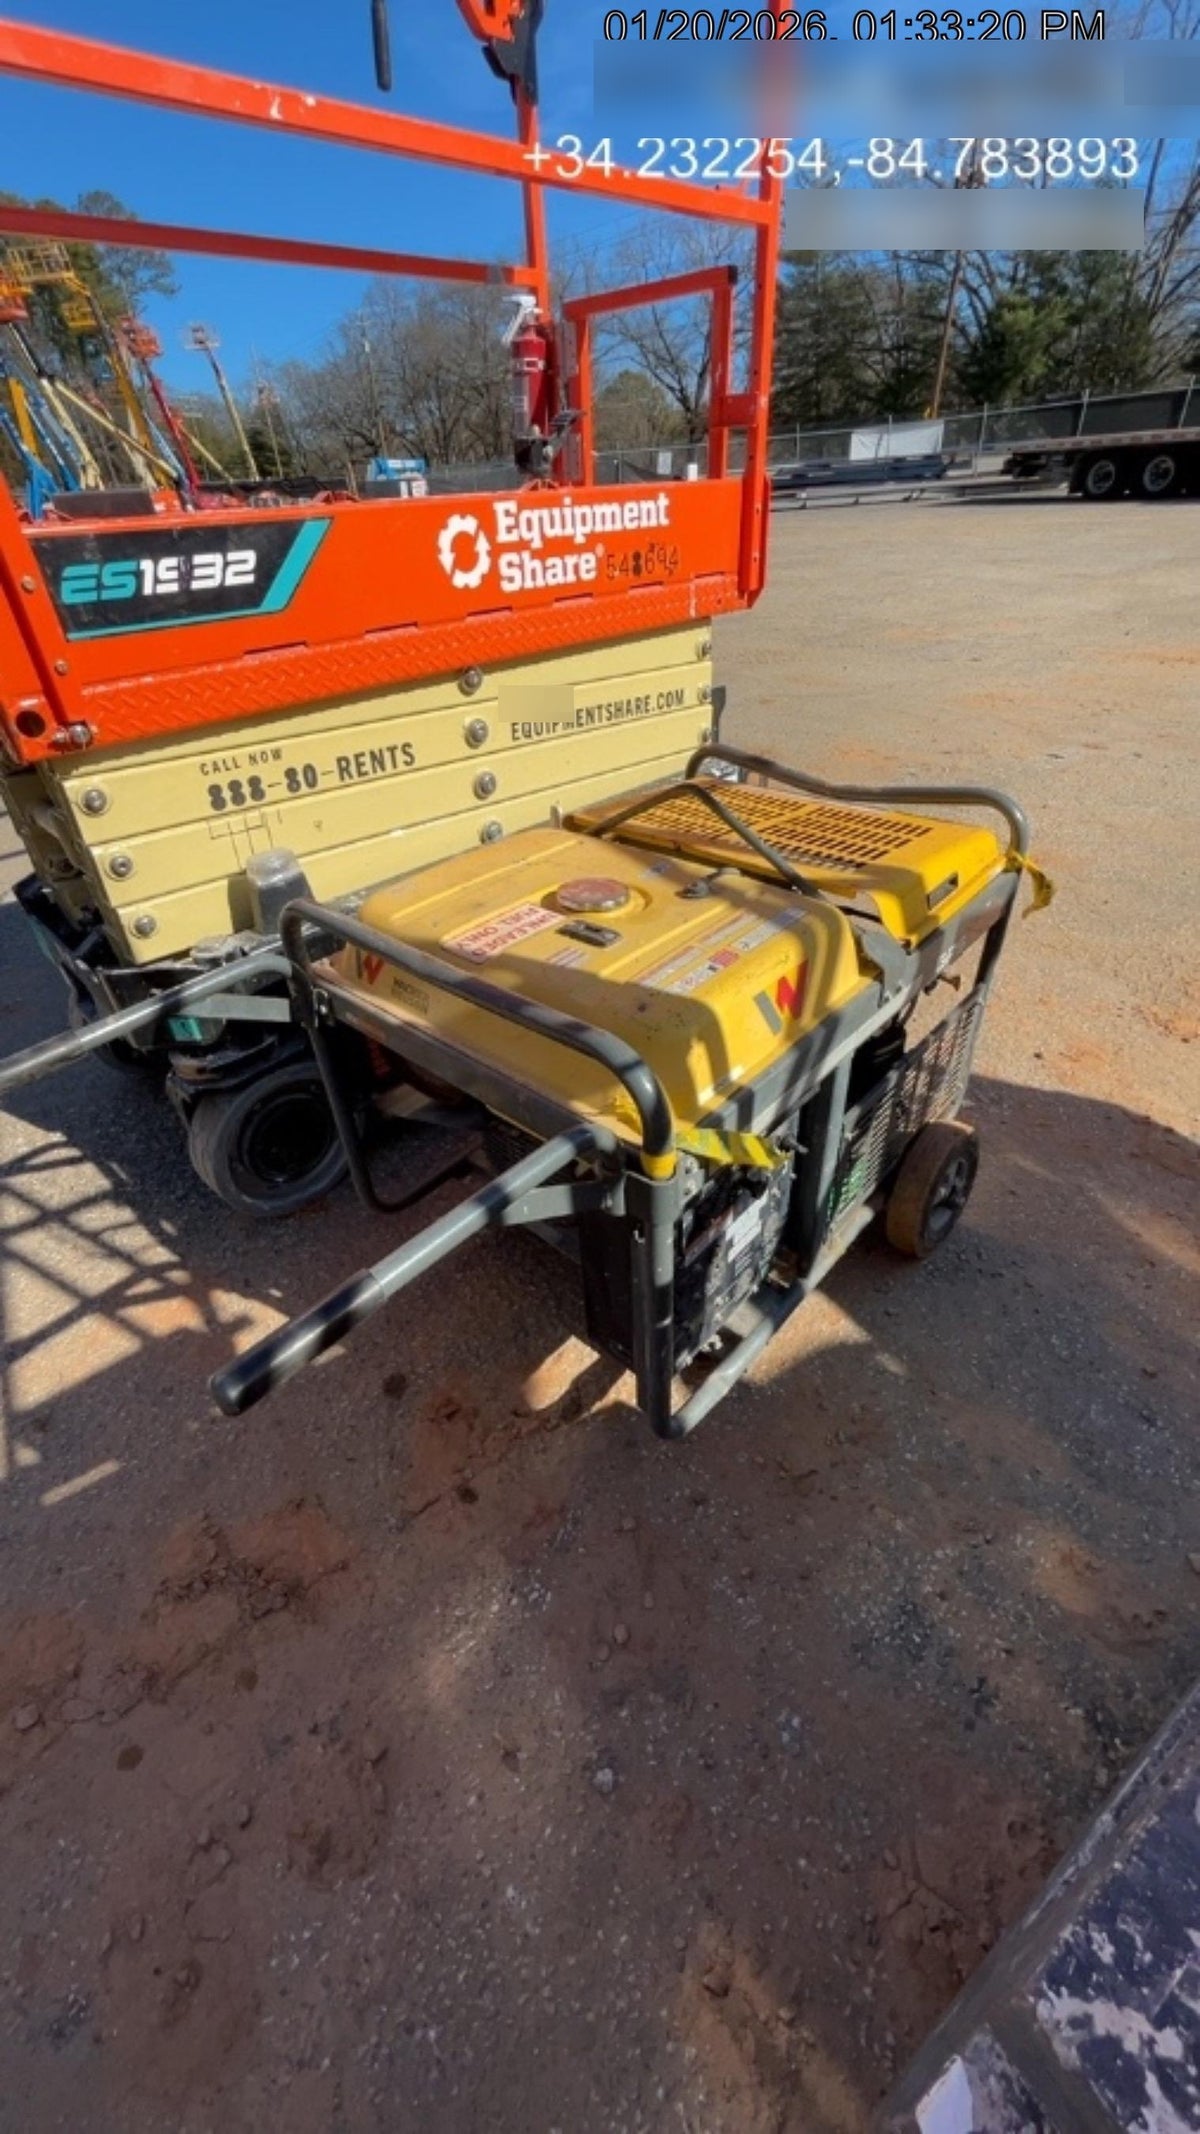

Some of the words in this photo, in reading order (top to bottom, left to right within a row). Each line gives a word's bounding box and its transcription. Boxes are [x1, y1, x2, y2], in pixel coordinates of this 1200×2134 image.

[492, 492, 670, 549] Equipment
[60, 549, 258, 605] ES1932
[200, 756, 241, 776] CALL
[248, 748, 283, 766] NOW
[207, 742, 416, 812] 888-80-RENTS
